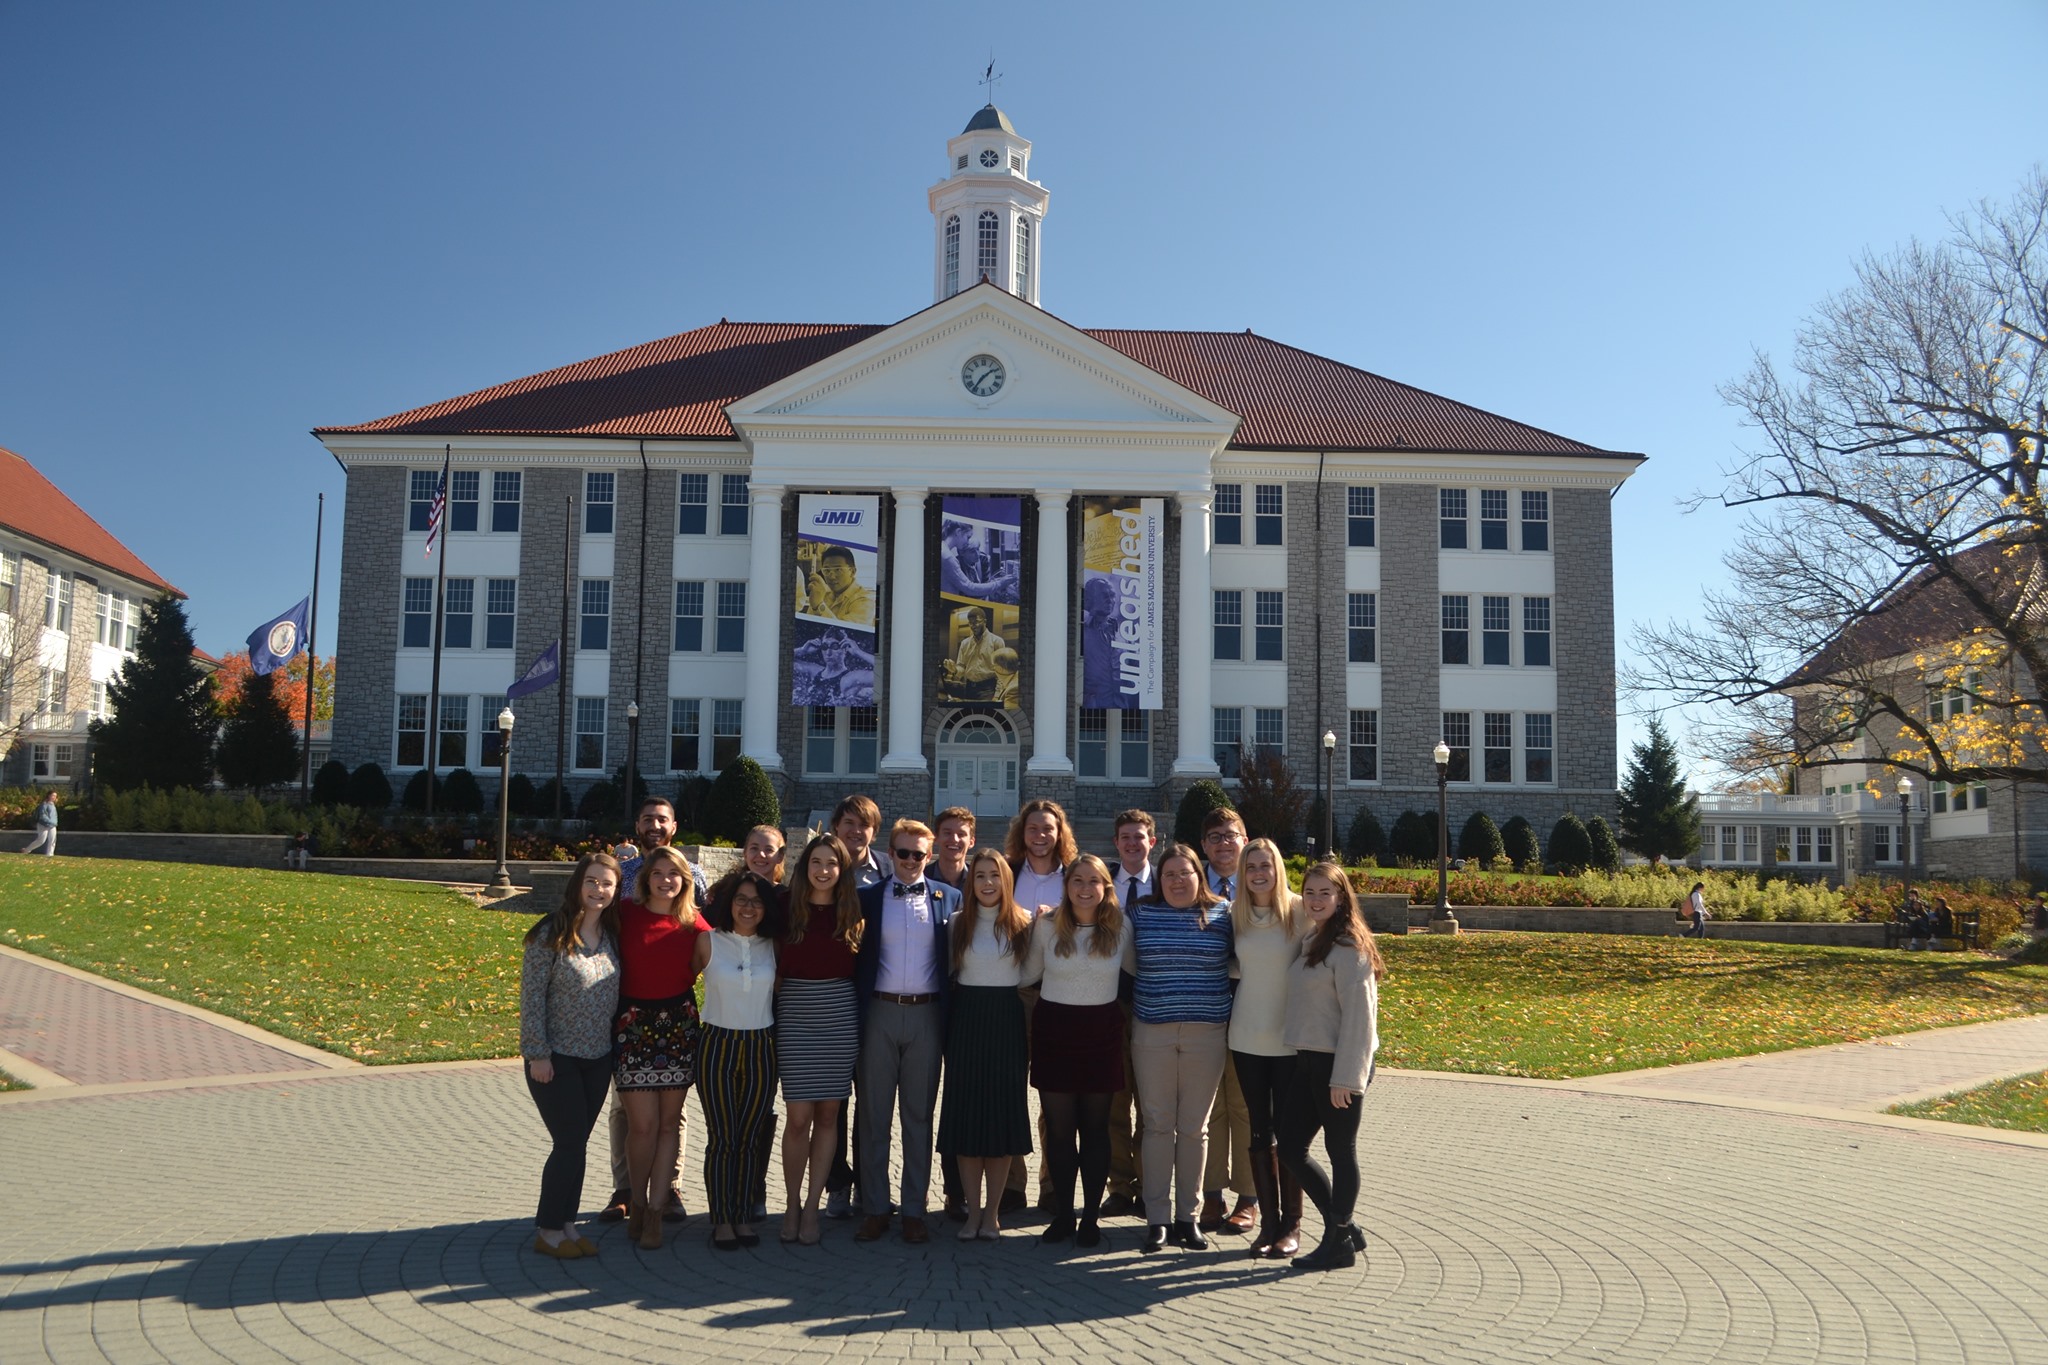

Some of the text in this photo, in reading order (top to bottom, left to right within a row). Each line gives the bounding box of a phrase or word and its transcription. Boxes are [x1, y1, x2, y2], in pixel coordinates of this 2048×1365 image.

[815, 511, 861, 524] JMU
[1148, 516, 1156, 562] UNIVERSITY
[1111, 509, 1141, 695] unleashed
[1147, 641, 1156, 679] Campaign
